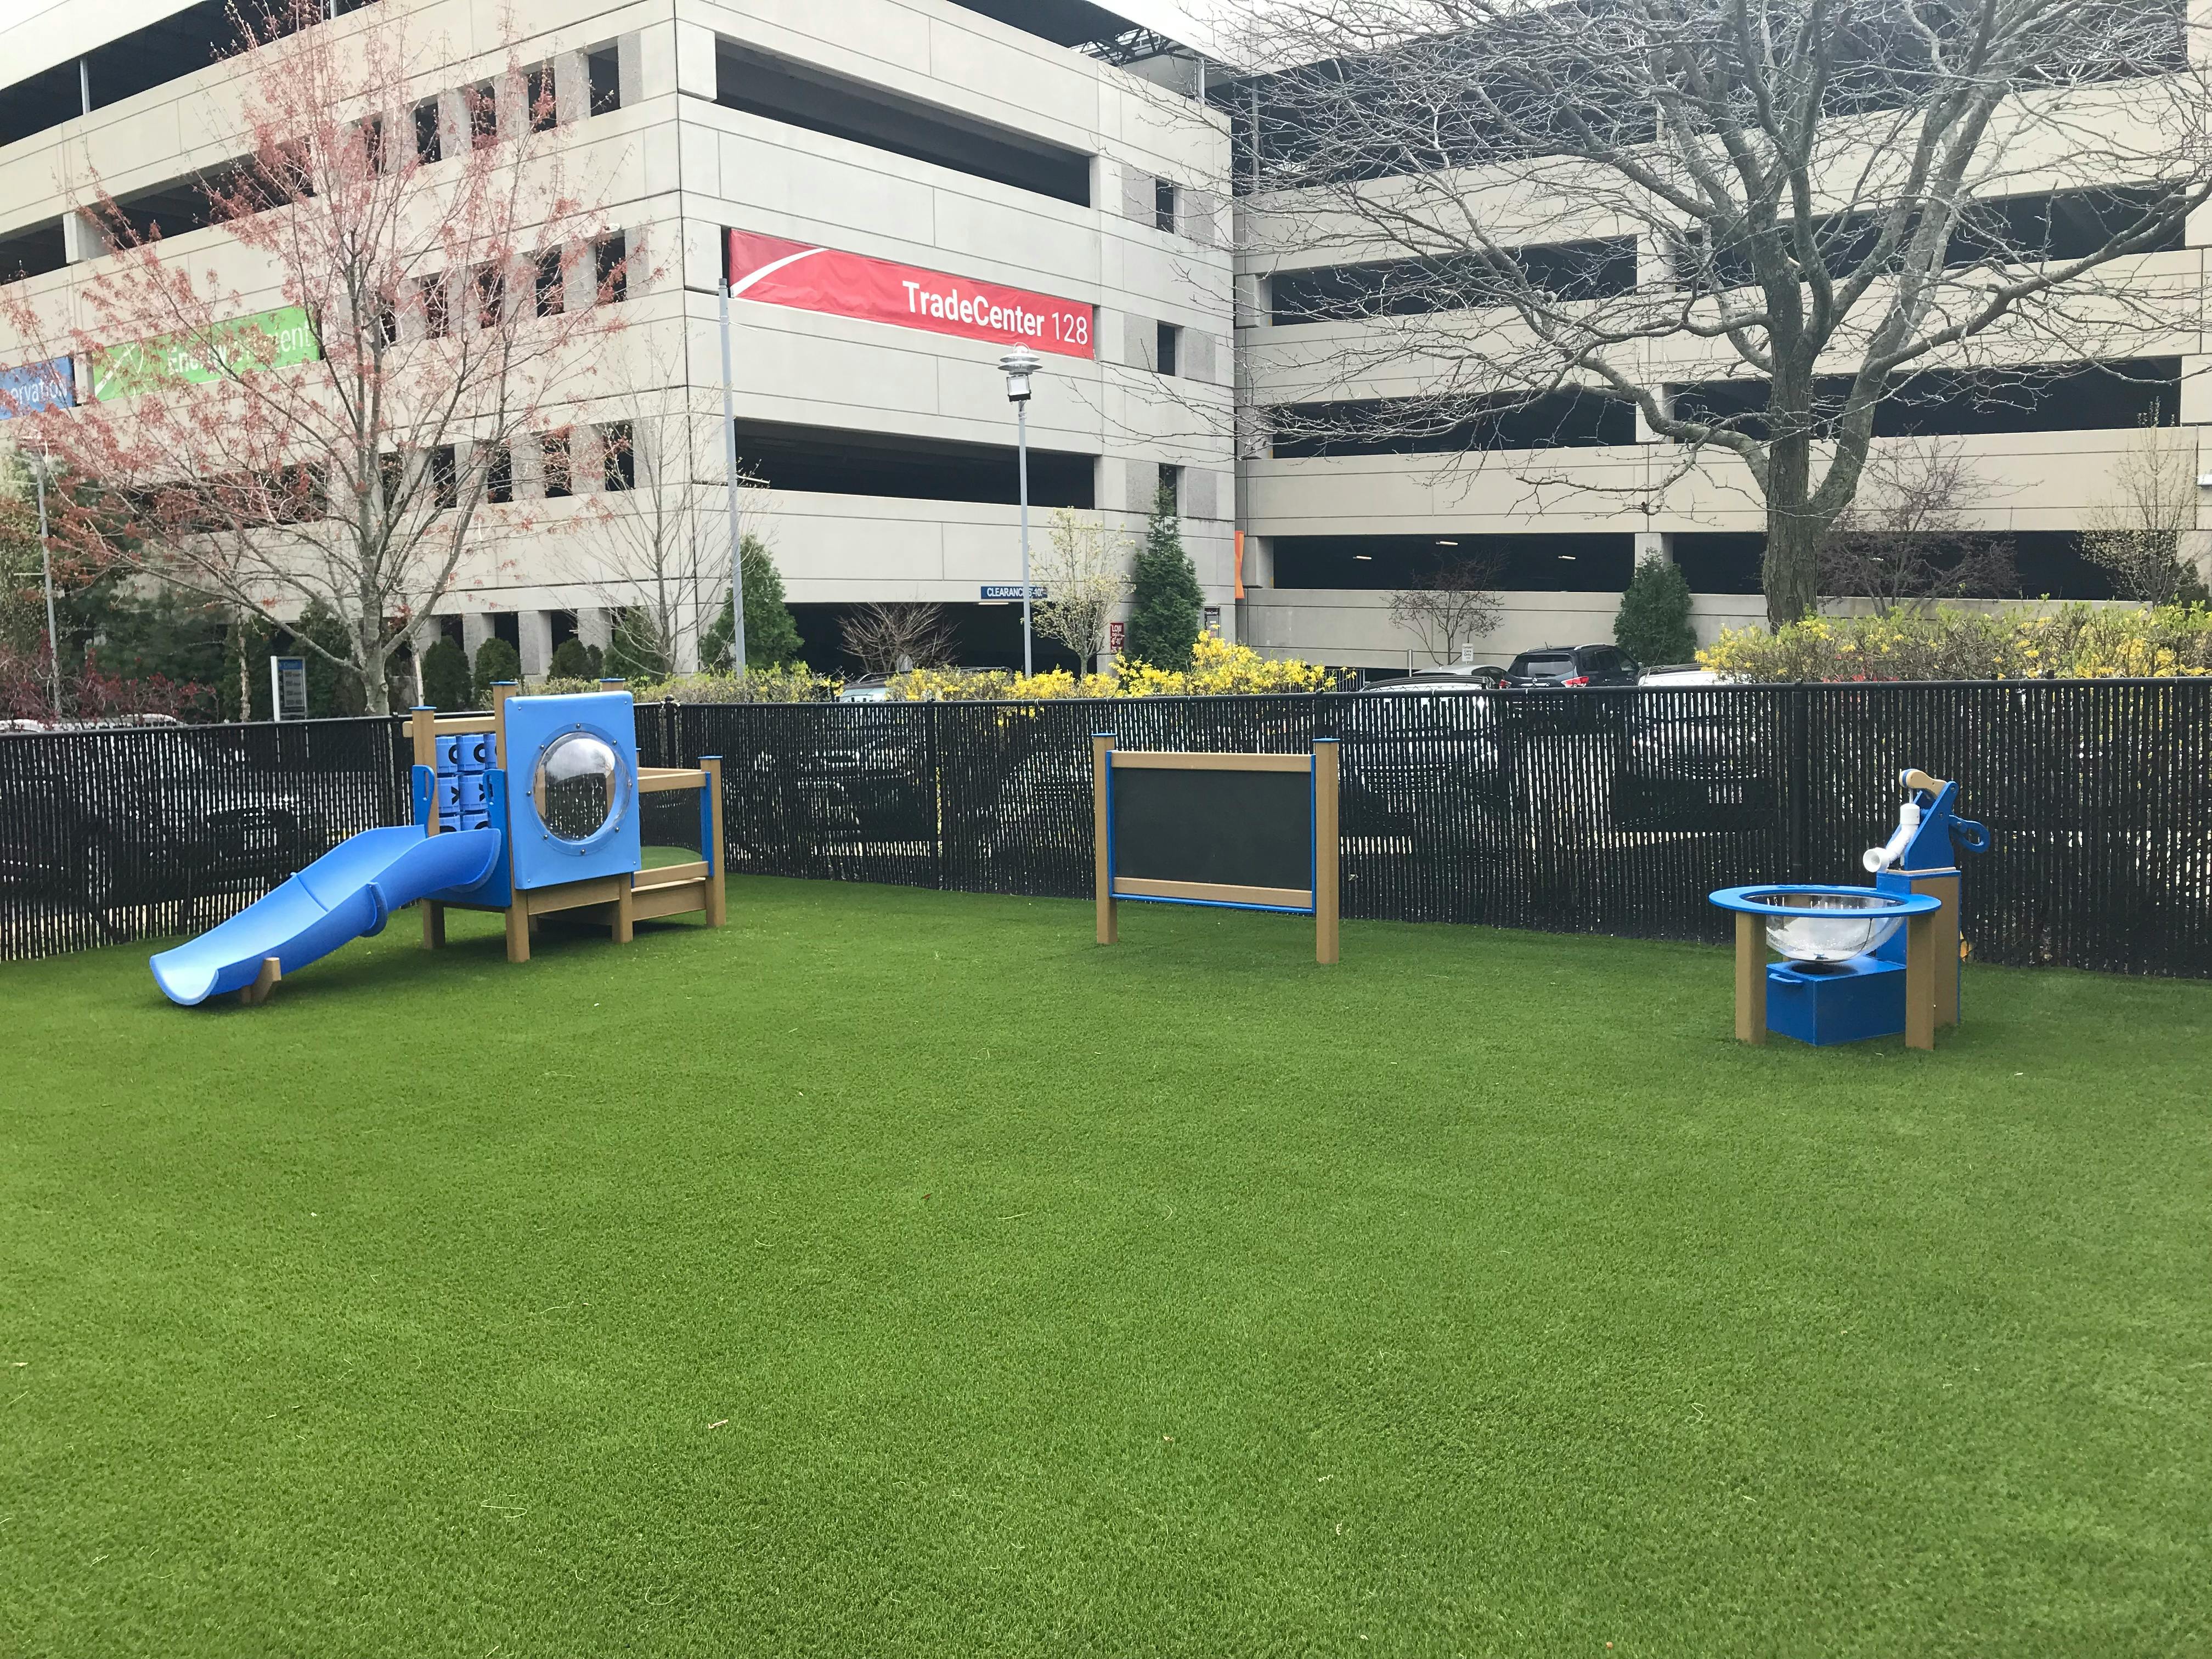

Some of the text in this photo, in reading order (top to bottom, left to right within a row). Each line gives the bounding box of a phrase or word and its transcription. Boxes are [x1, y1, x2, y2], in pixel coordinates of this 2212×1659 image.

[902, 281, 1088, 345] TradeCenter 128
[987, 587, 1025, 597] CLEARANC
